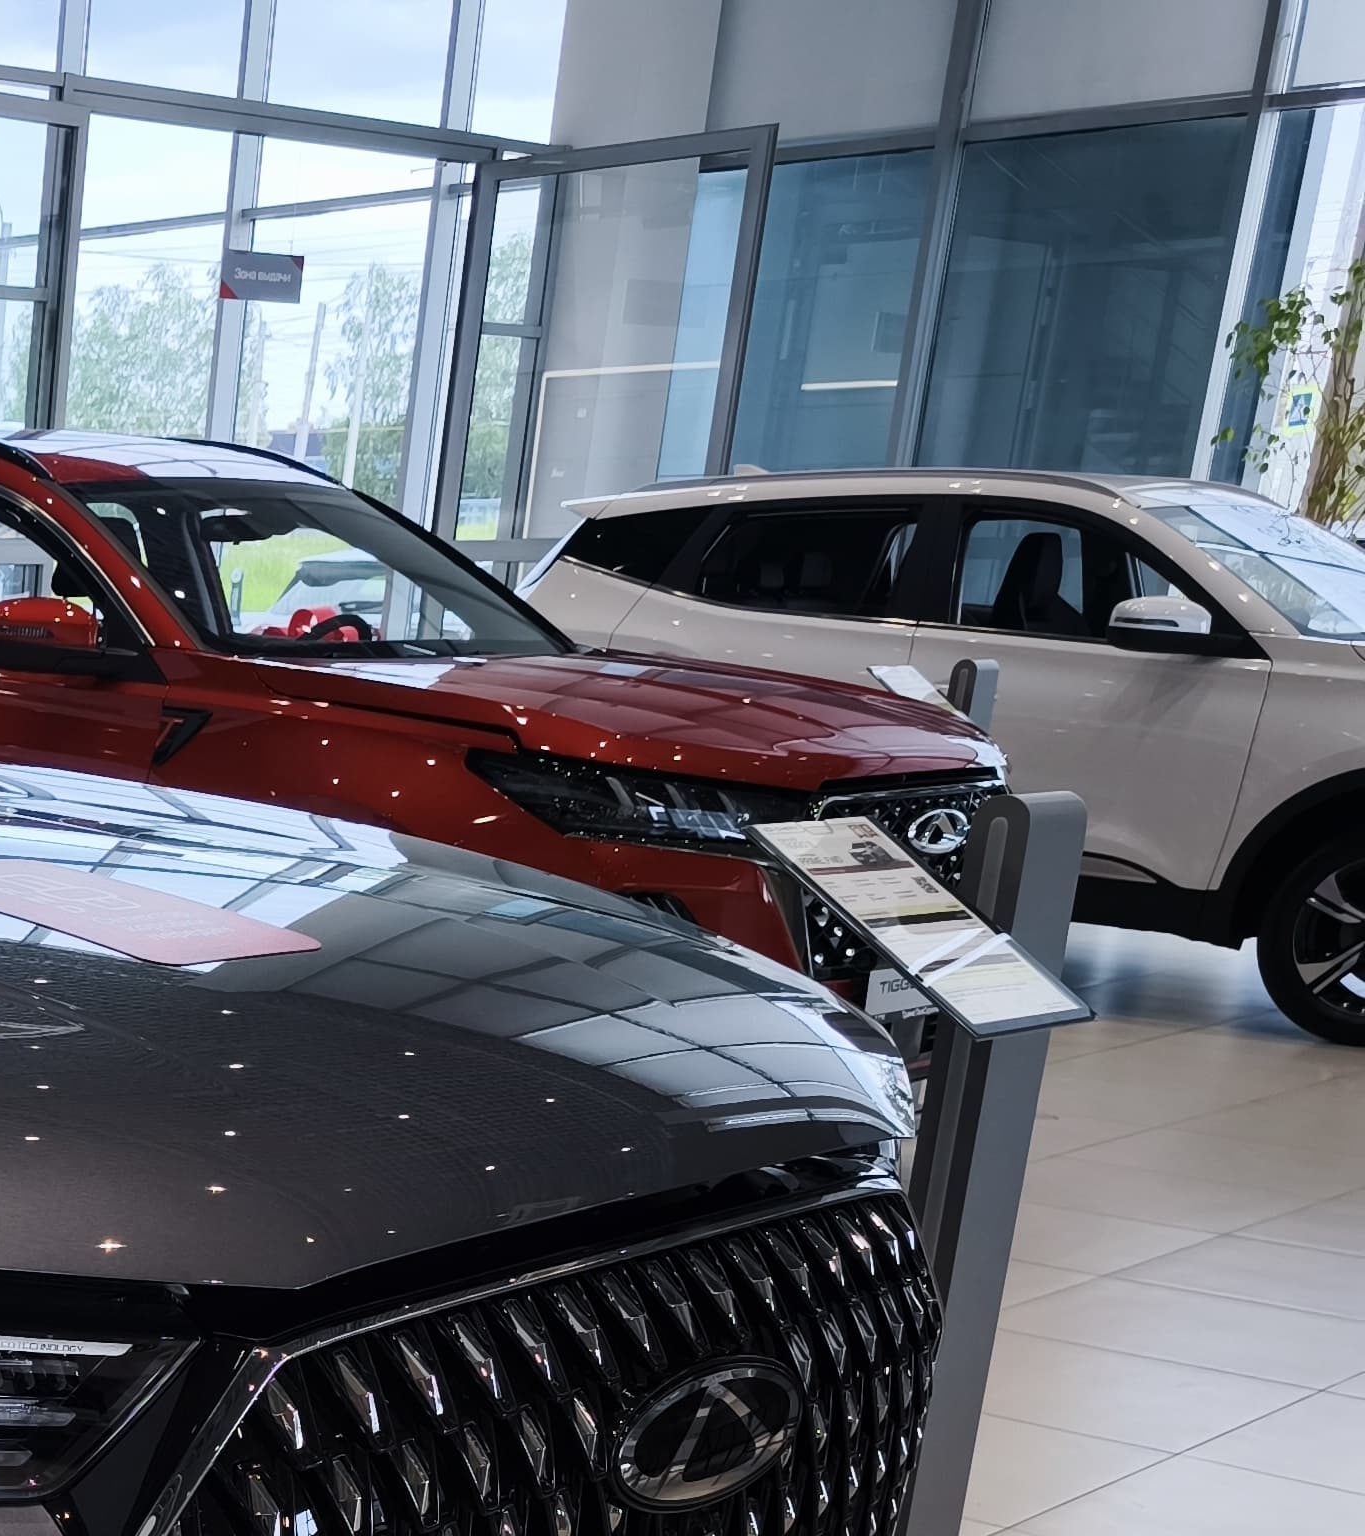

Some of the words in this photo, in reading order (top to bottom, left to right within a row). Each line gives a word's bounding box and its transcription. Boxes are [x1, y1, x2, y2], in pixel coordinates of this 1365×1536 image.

[234, 267, 257, 281] Зона
[258, 272, 291, 283] выдачи
[880, 979, 918, 994] TIGG
